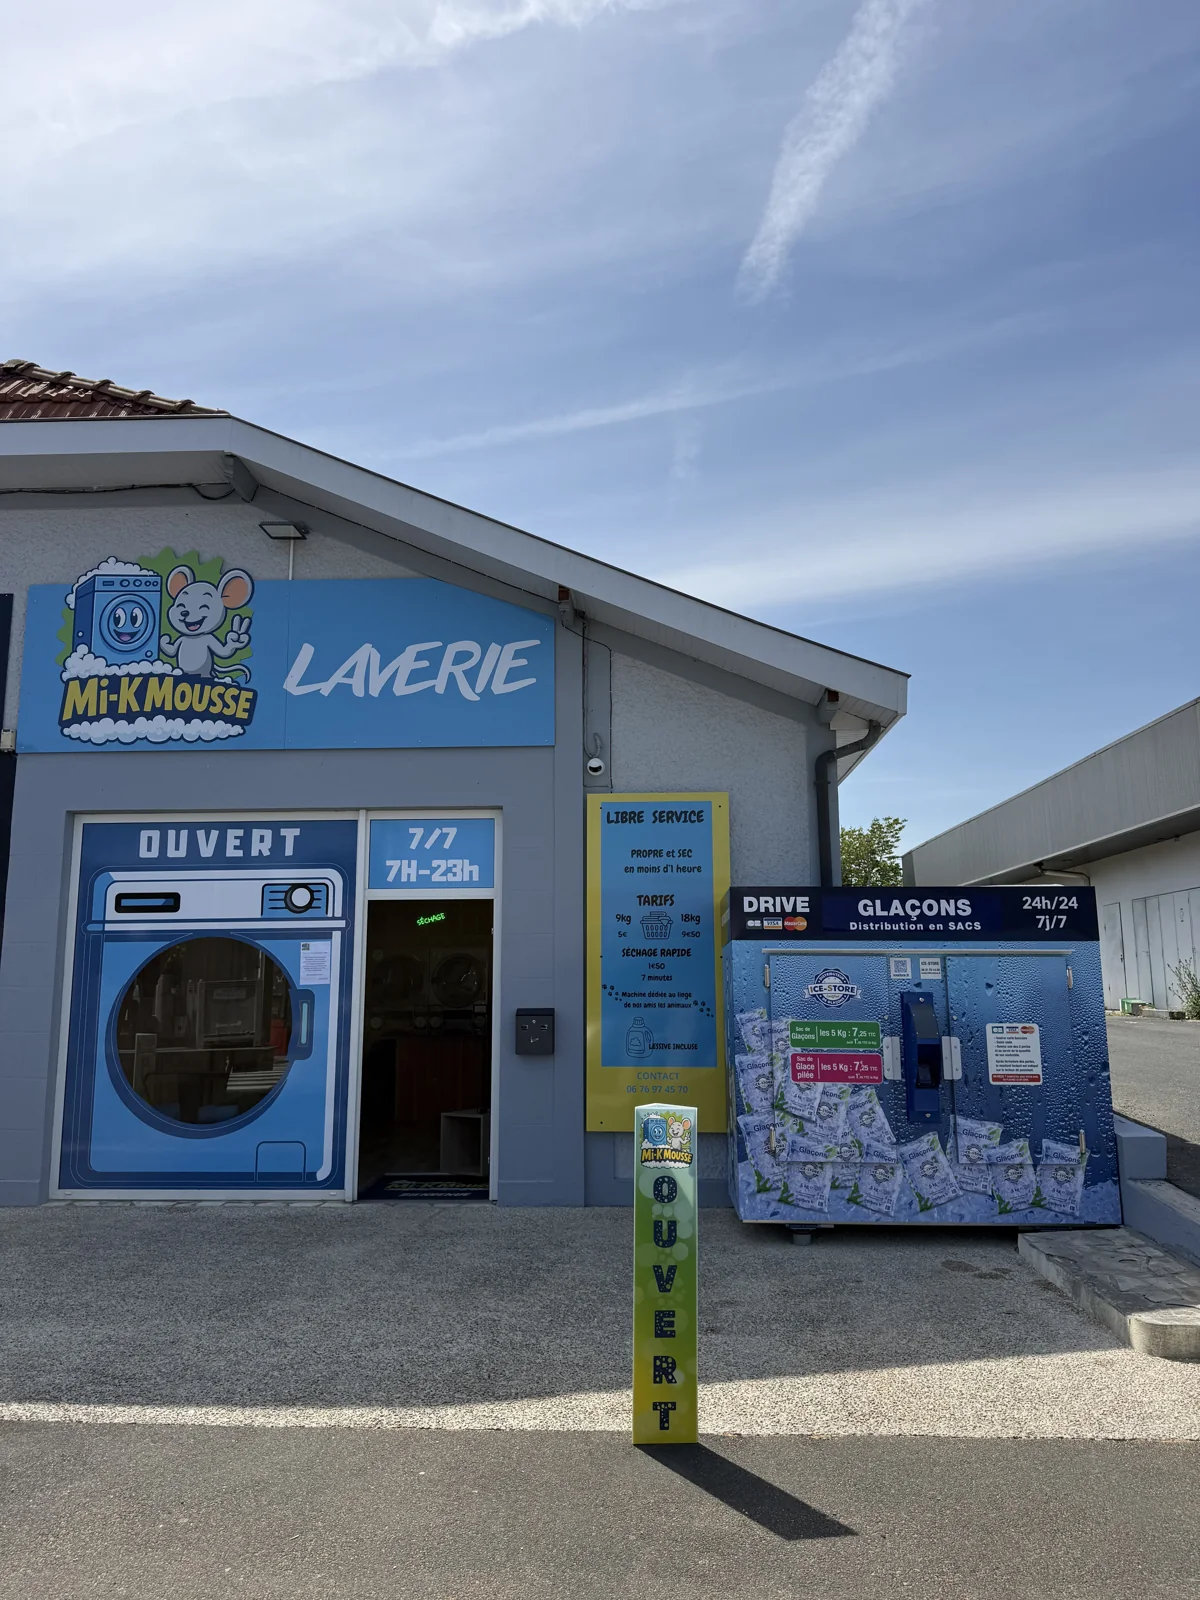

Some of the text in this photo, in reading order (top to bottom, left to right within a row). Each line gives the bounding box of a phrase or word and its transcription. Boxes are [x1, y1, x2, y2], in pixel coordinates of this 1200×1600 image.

[283, 639, 541, 701] LAVERIE
[62, 677, 253, 721] Mi-K MOUSSE
[606, 809, 705, 824] LIBRE SERVICE
[139, 828, 300, 858] OUVERT
[408, 827, 458, 850] 7/7
[631, 849, 693, 858] PROPRE et SEC
[385, 859, 480, 883] 7H-23h
[624, 865, 634, 873] en
[637, 865, 660, 873] moins
[676, 864, 702, 873] heure
[636, 894, 675, 906] TARIFS
[743, 896, 810, 913] DRIVE
[1022, 896, 1078, 910] 24h/24
[857, 899, 972, 920] GLAÇONS
[615, 913, 632, 925] 9kg
[681, 913, 701, 925] 18kg
[1035, 915, 1067, 931] 7j/7
[850, 921, 981, 931] Distribution en SACS
[621, 946, 692, 957] SÉCHAGE RAPIDE
[677, 991, 692, 999] linge
[810, 985, 856, 994] ICE-STORE
[792, 1032, 815, 1041] Glaçons
[820, 1029, 830, 1037] les
[837, 1029, 847, 1038] Kg
[795, 1062, 815, 1070] Glace
[821, 1063, 831, 1071] les
[839, 1063, 848, 1072] Kg
[636, 1072, 680, 1080] CONTACT
[797, 1071, 814, 1080] pilée
[626, 1085, 688, 1093] 06 76 97 45 70
[641, 1148, 693, 1163] Mi-K MOUSSE
[652, 1175, 678, 1430] OUVERT
